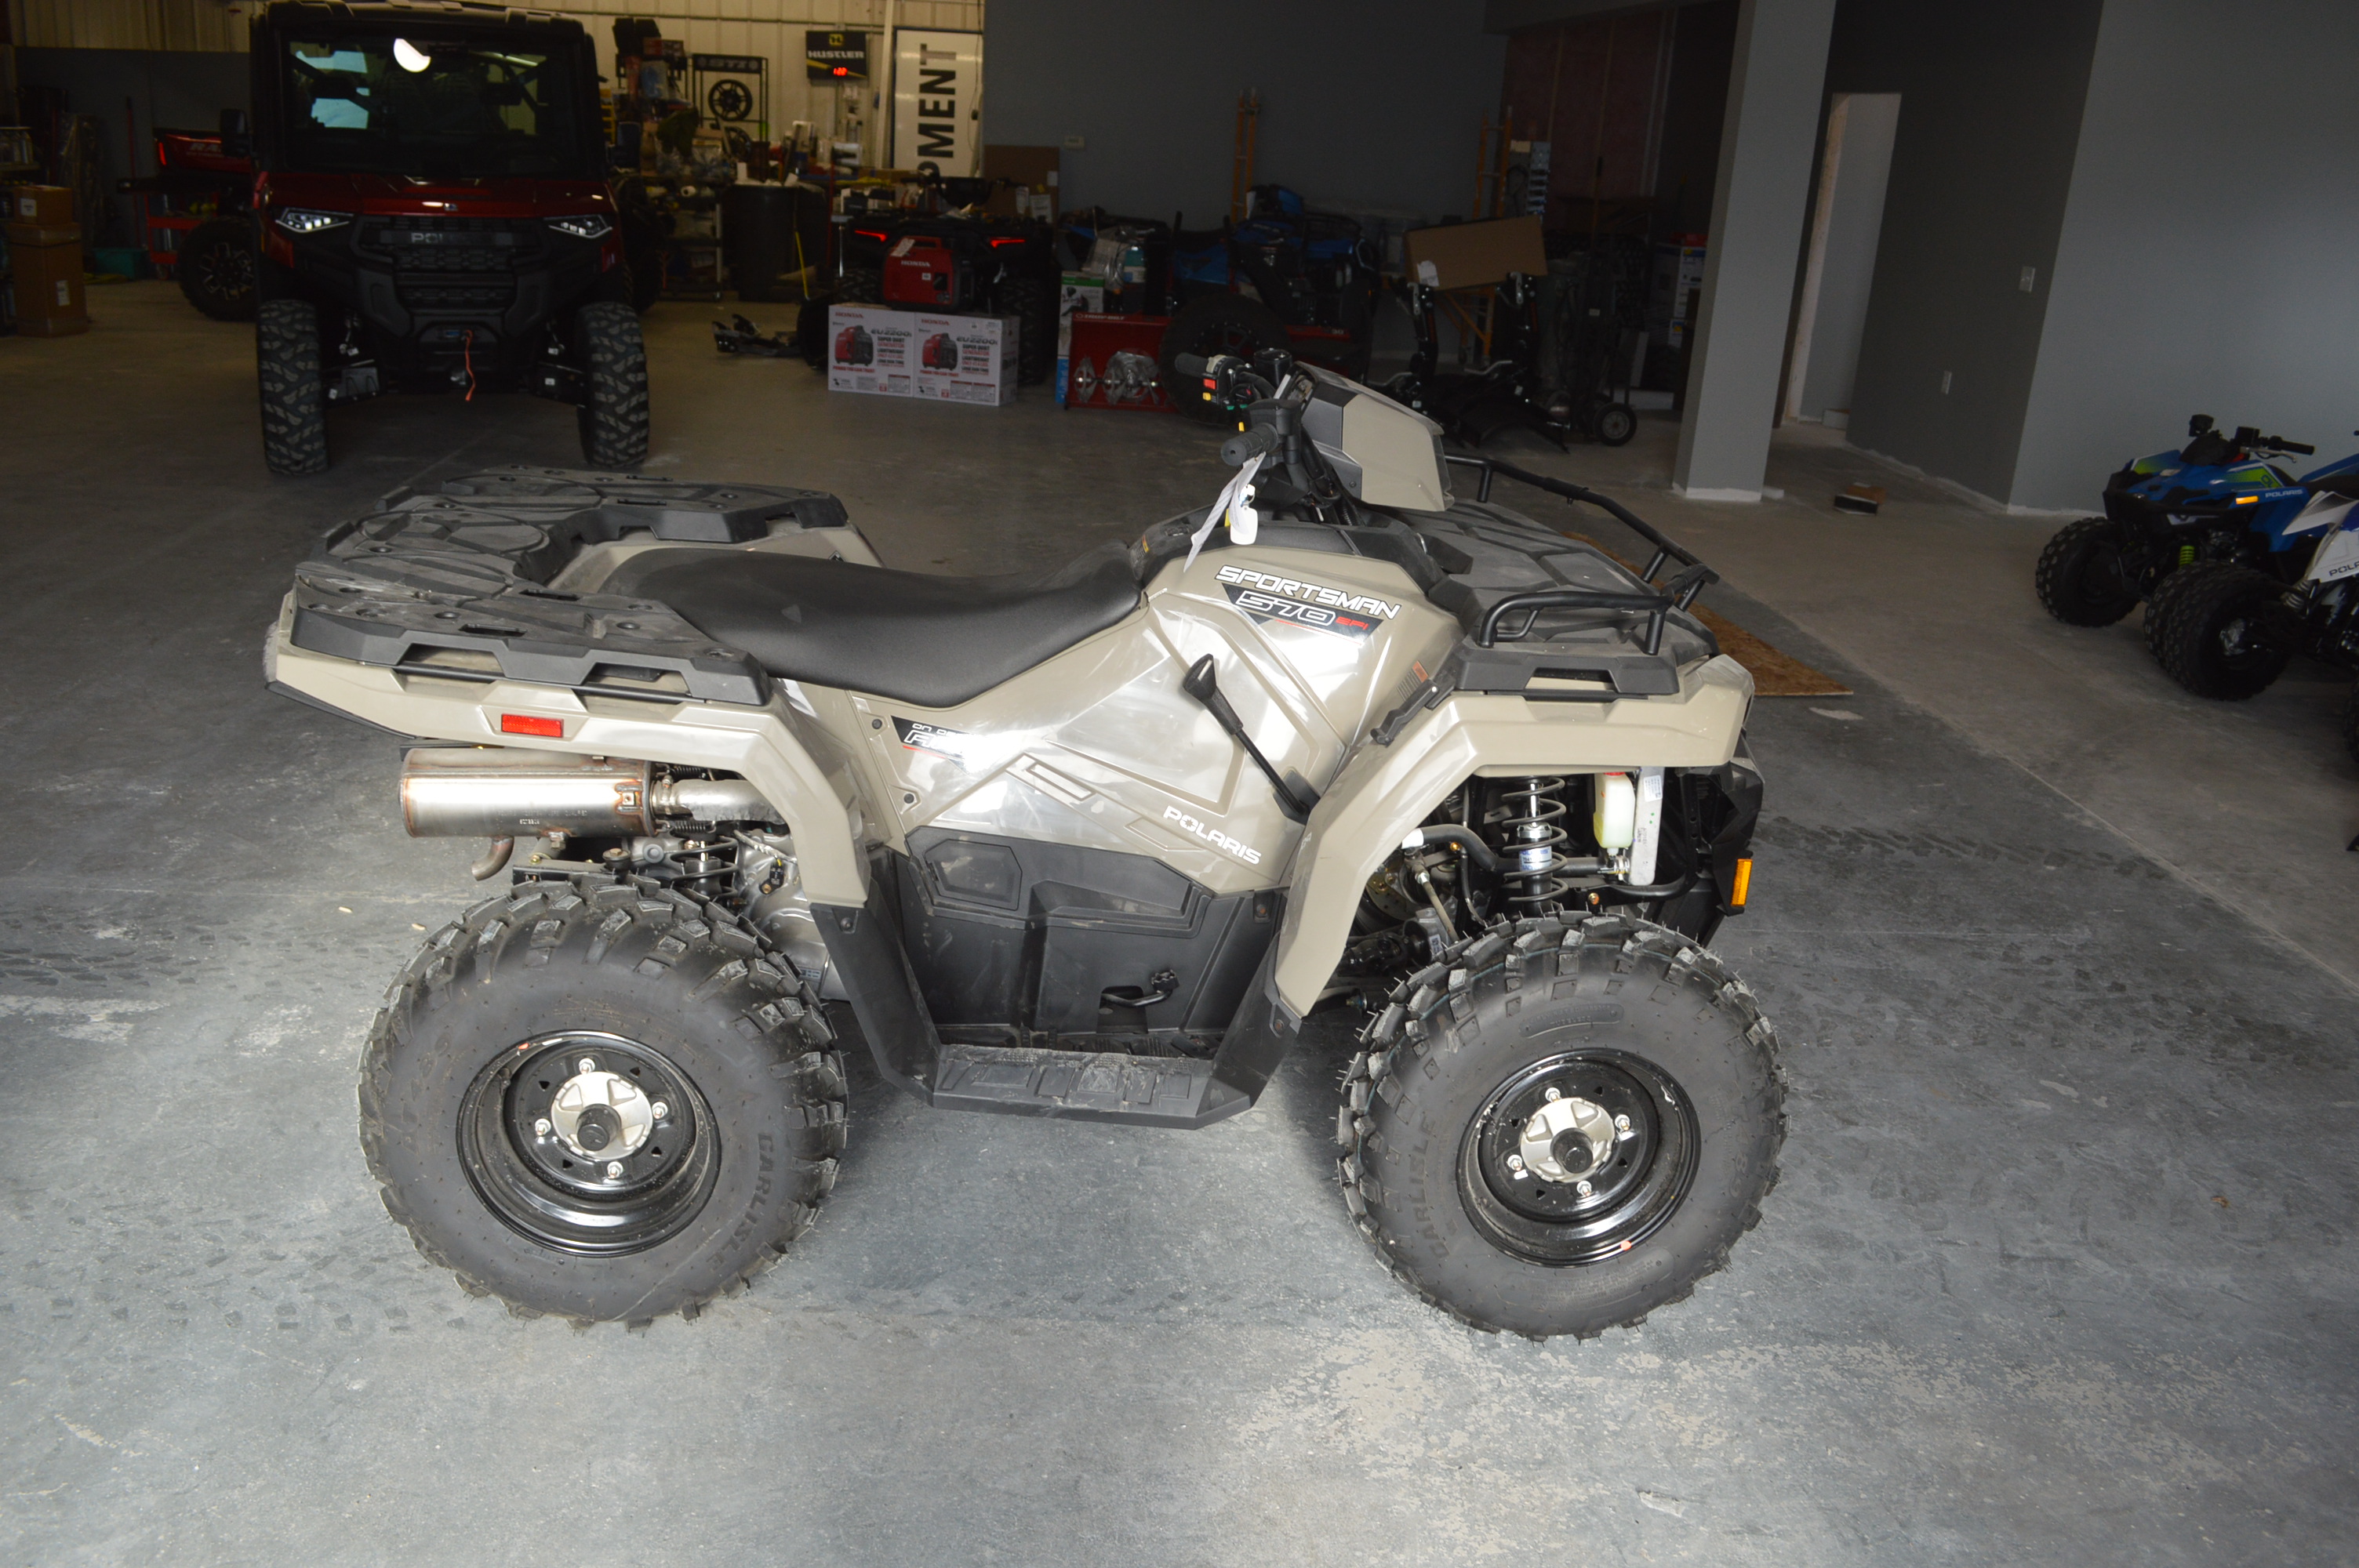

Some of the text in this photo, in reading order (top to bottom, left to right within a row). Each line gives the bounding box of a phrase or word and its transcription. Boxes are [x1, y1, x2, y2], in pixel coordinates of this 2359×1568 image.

[2266, 489, 2303, 498] POLARIS
[1215, 564, 1401, 619] SPORTSMAN
[1236, 590, 1369, 630] 570 EFI
[1163, 805, 1261, 865] POLARIS
[707, 1132, 773, 1272] CARLISLE
[1409, 1116, 1449, 1258] CARLISLE
